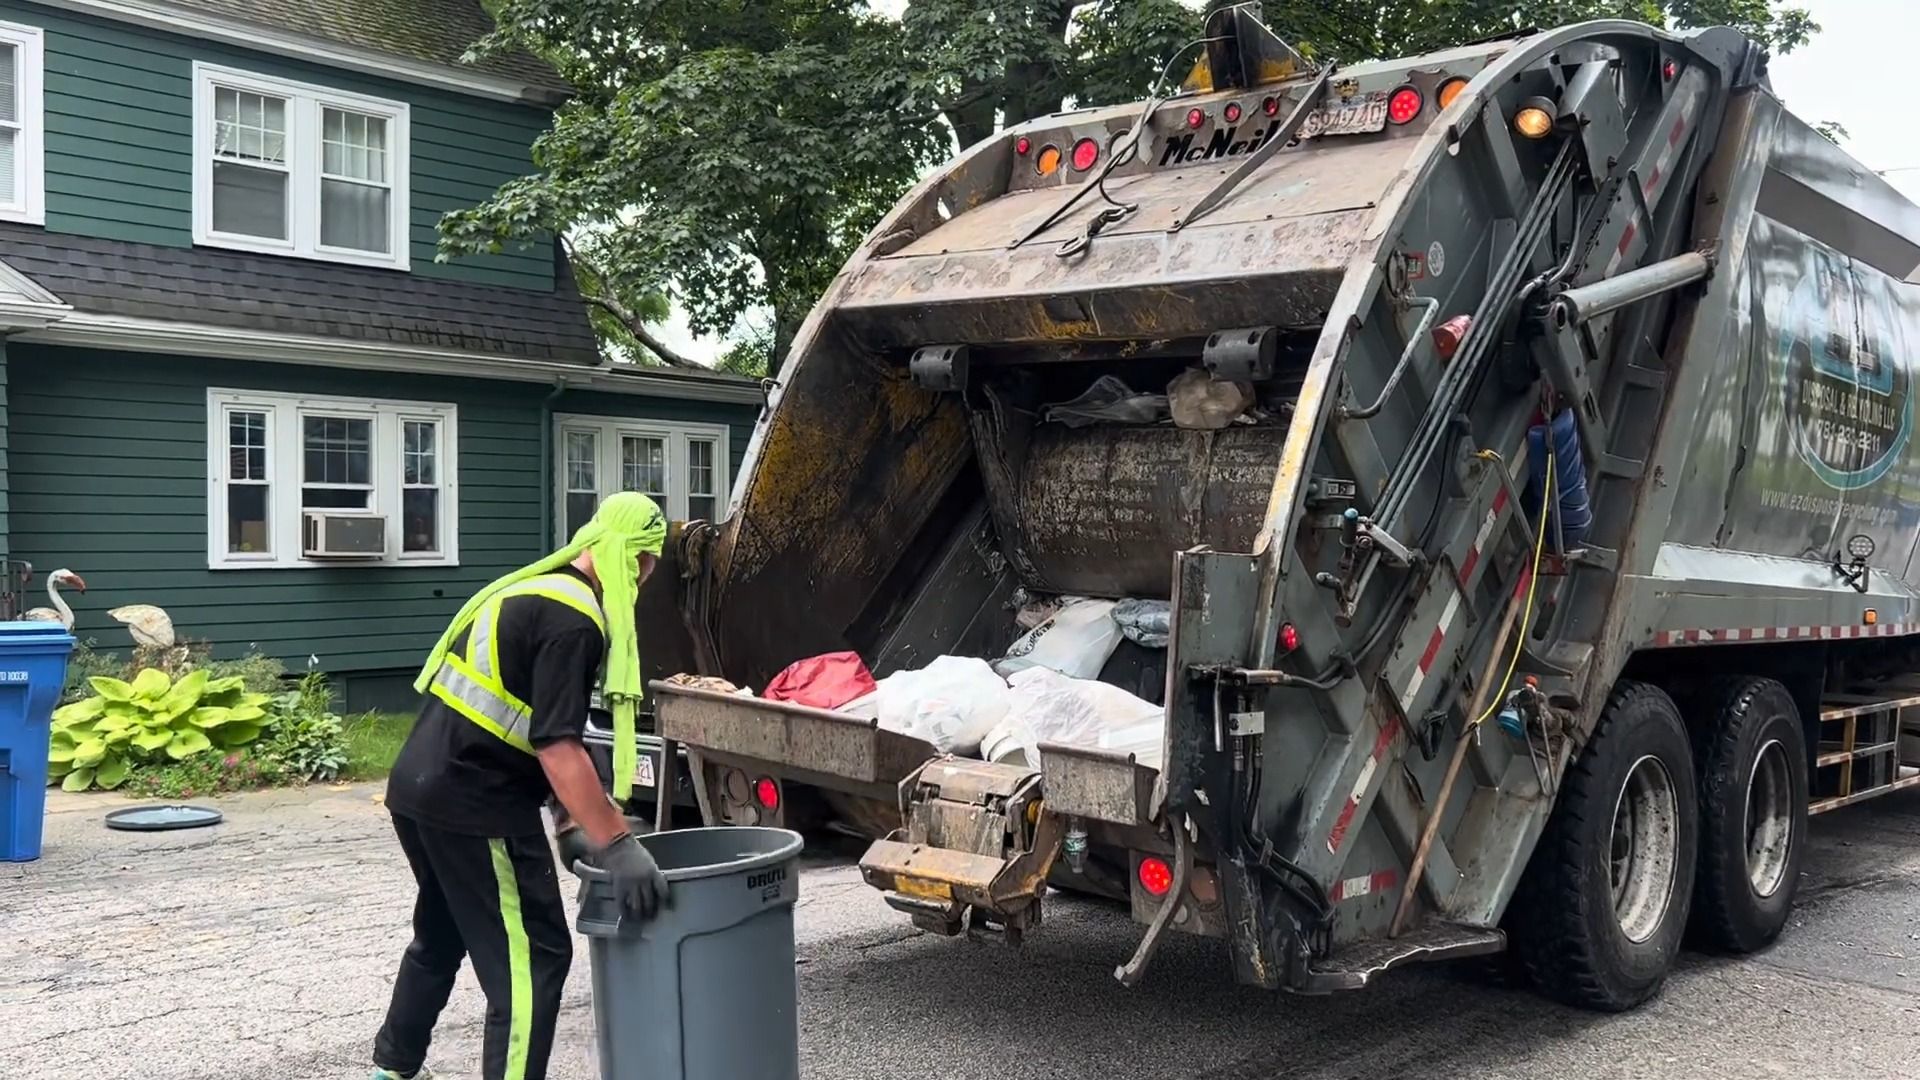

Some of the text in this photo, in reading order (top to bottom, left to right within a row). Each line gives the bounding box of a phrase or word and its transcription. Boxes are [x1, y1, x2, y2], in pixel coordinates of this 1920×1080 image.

[1159, 119, 1300, 166] McNeils
[1802, 379, 1838, 414] DISPOSAL
[1839, 392, 1846, 416] &
[1883, 405, 1896, 431] LLC
